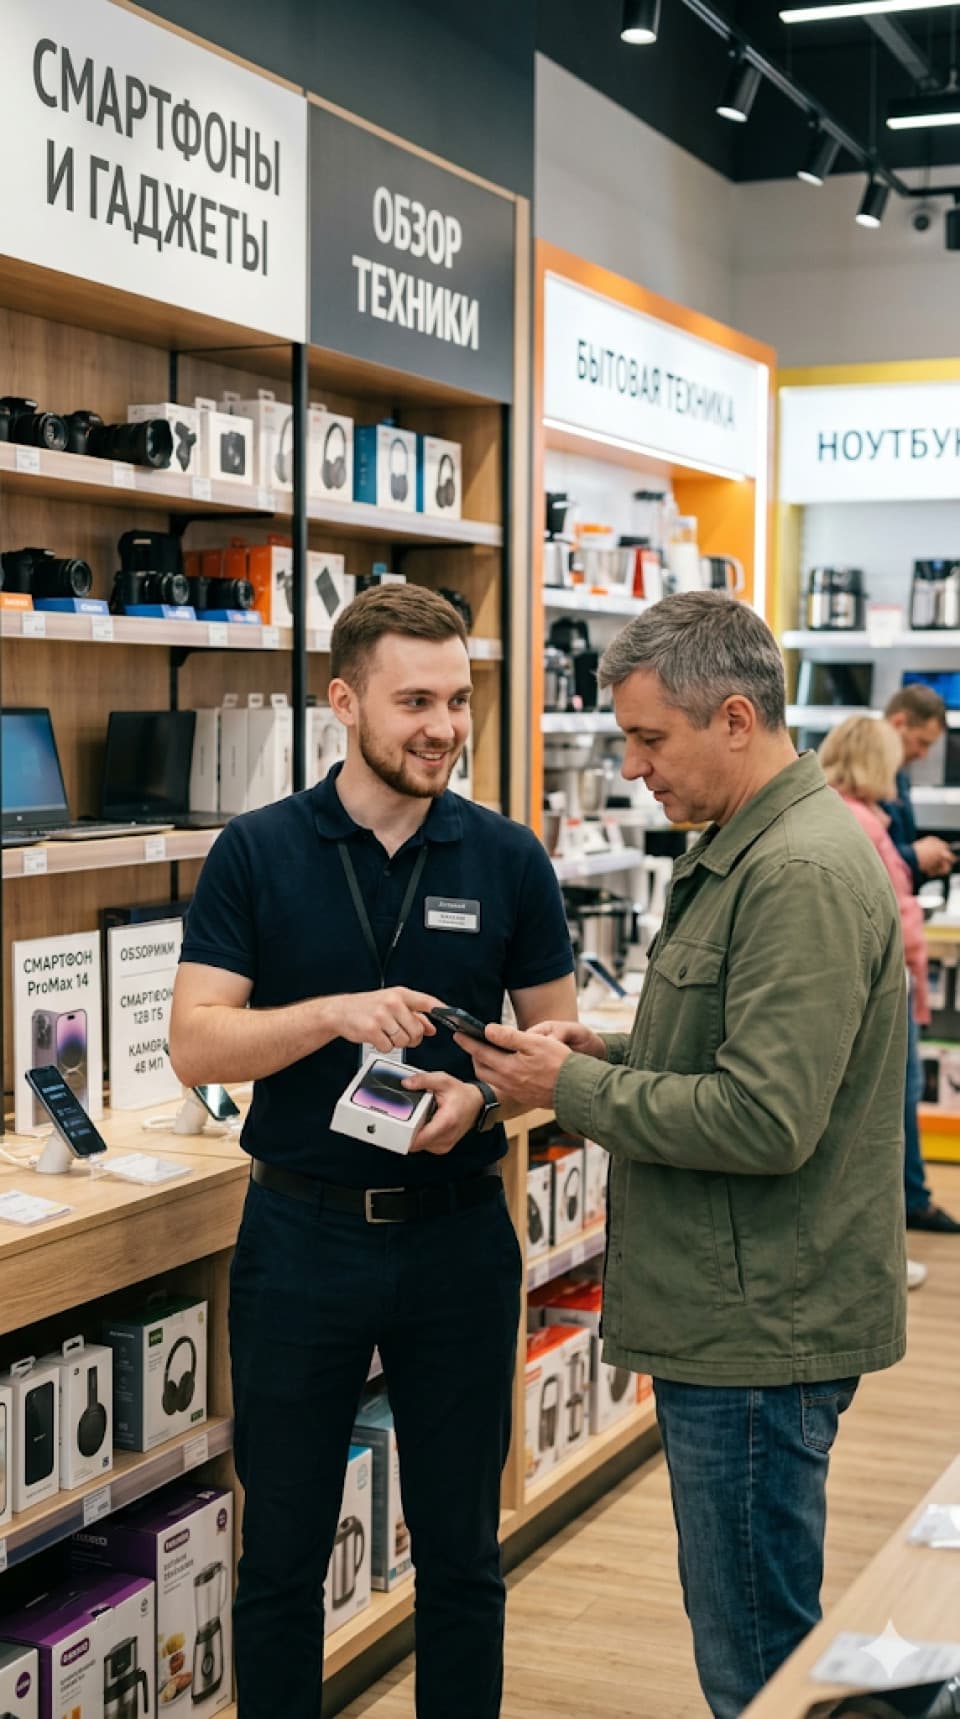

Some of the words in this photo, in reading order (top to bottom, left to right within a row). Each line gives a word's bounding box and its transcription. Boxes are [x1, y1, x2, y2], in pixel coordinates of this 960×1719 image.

[33, 38, 280, 196] СМАРТФОНЫ
[46, 138, 75, 212] И
[90, 154, 268, 277] ГАДЖЕТЫ
[373, 186, 463, 269] ОБЗОР
[352, 254, 480, 351] ТЕХНИКИ
[577, 338, 661, 407] БЫТОВАЯ
[666, 371, 737, 431] ТЕХНИКА
[23, 949, 92, 974] СМАРТФОН
[28, 976, 73, 996] ProMax
[76, 972, 88, 987] 14
